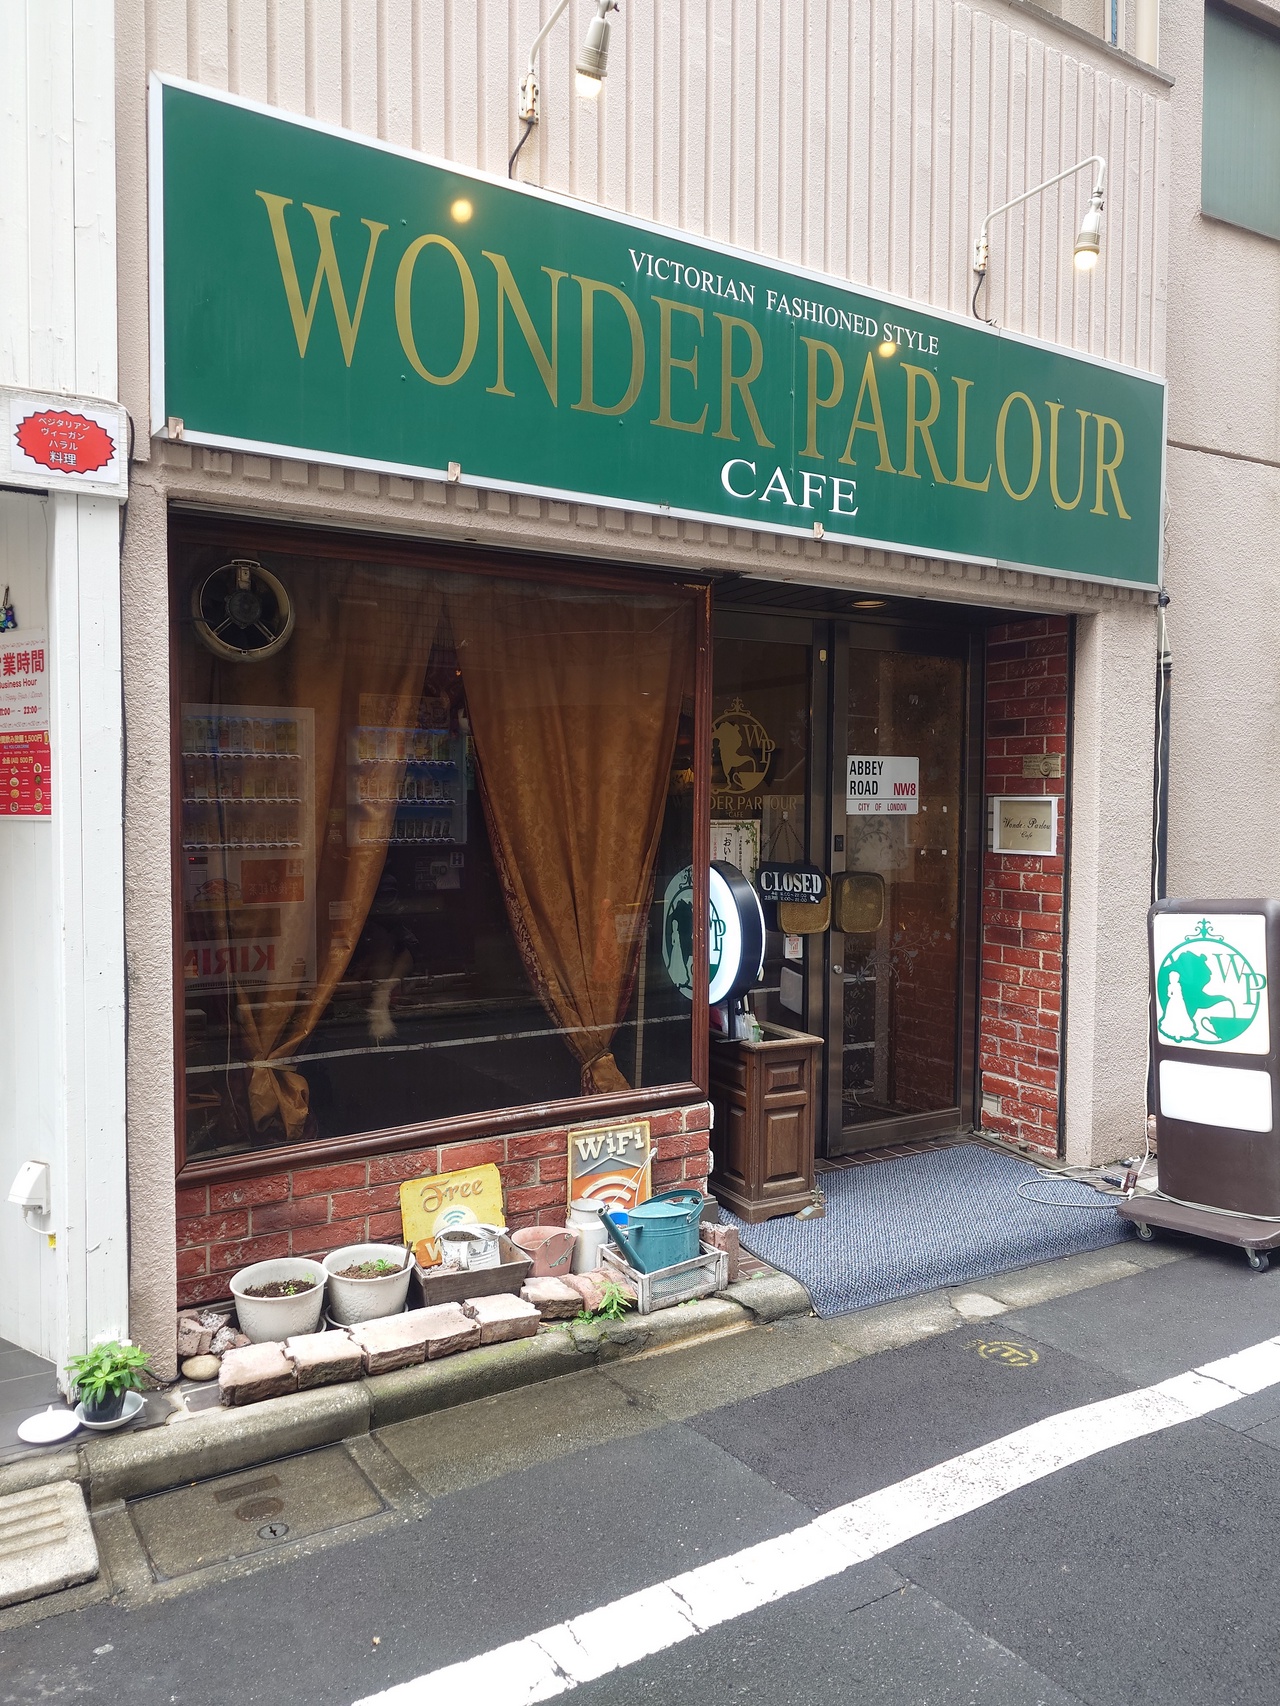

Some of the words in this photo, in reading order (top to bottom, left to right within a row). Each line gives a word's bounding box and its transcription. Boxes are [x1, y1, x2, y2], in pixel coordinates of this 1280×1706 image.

[629, 249, 755, 305] VICTORIAN
[767, 290, 878, 338] FASHIONED
[883, 322, 939, 356] STYLE
[255, 190, 776, 448] WONDER
[799, 336, 1131, 520] PARLOUR
[38, 417, 90, 431] ベジタリアン
[41, 427, 85, 441] ヴィーガン
[49, 440, 78, 451] ハラル
[49, 451, 77, 466] 料理
[720, 458, 859, 516] CAFE
[0, 649, 44, 676] 業時間
[23, 678, 37, 687] Hour
[849, 760, 884, 776] ABBEY
[849, 780, 879, 796] ROAD
[893, 783, 916, 796] NW8
[737, 796, 797, 810] PAROUR
[858, 802, 870, 811] CITY
[875, 802, 882, 811] OF
[887, 803, 907, 812] LONDON
[760, 871, 822, 894] CLOSED
[1212, 953, 1267, 1005] WP
[575, 1128, 645, 1161] WiFi
[420, 1178, 484, 1213] Free
